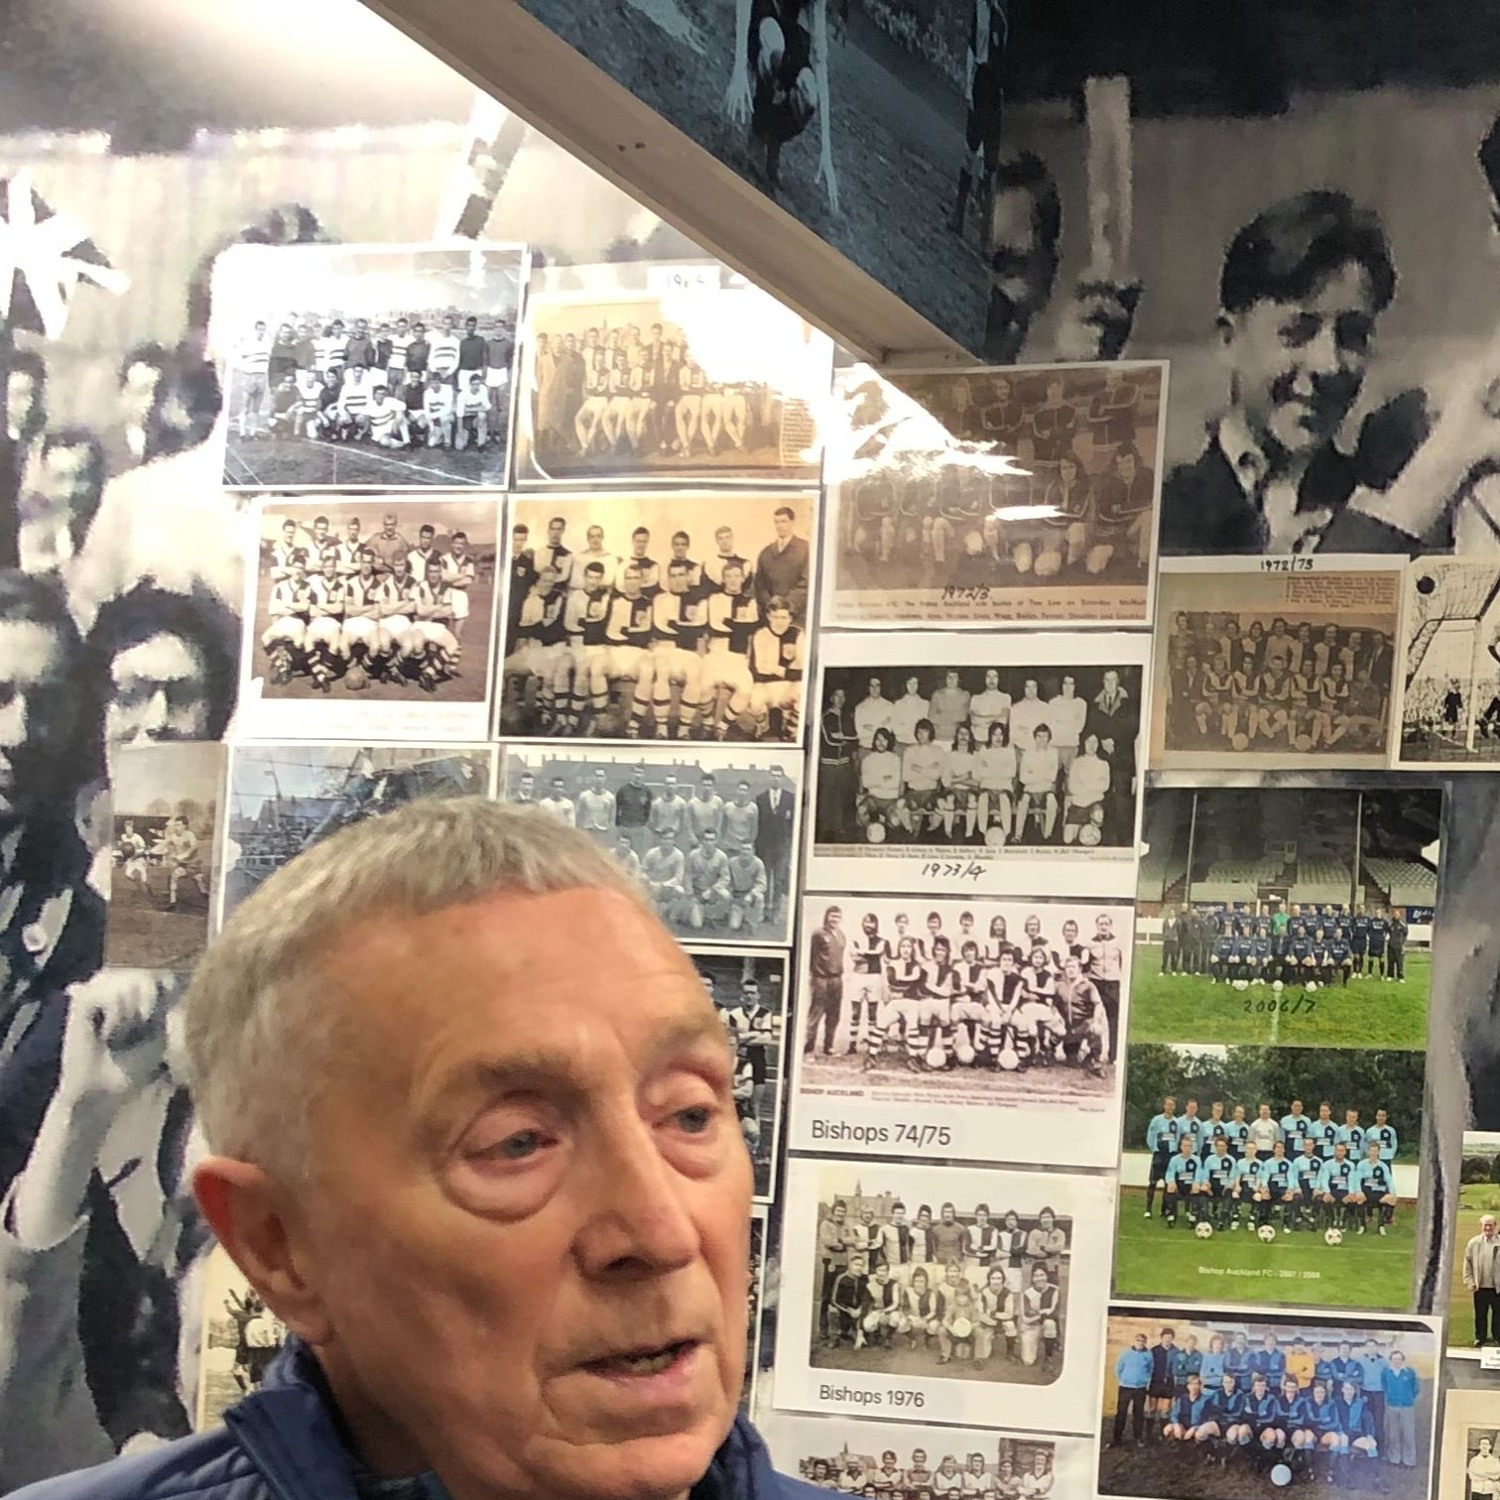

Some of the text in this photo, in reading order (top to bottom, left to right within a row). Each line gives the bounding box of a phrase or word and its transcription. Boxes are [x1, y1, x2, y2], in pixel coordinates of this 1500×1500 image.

[1261, 556, 1314, 572] 1972/73
[1243, 994, 1316, 1014] 2006/7
[811, 1119, 952, 1148] Bishops 74/75
[820, 1384, 925, 1408] Bishops 1976
